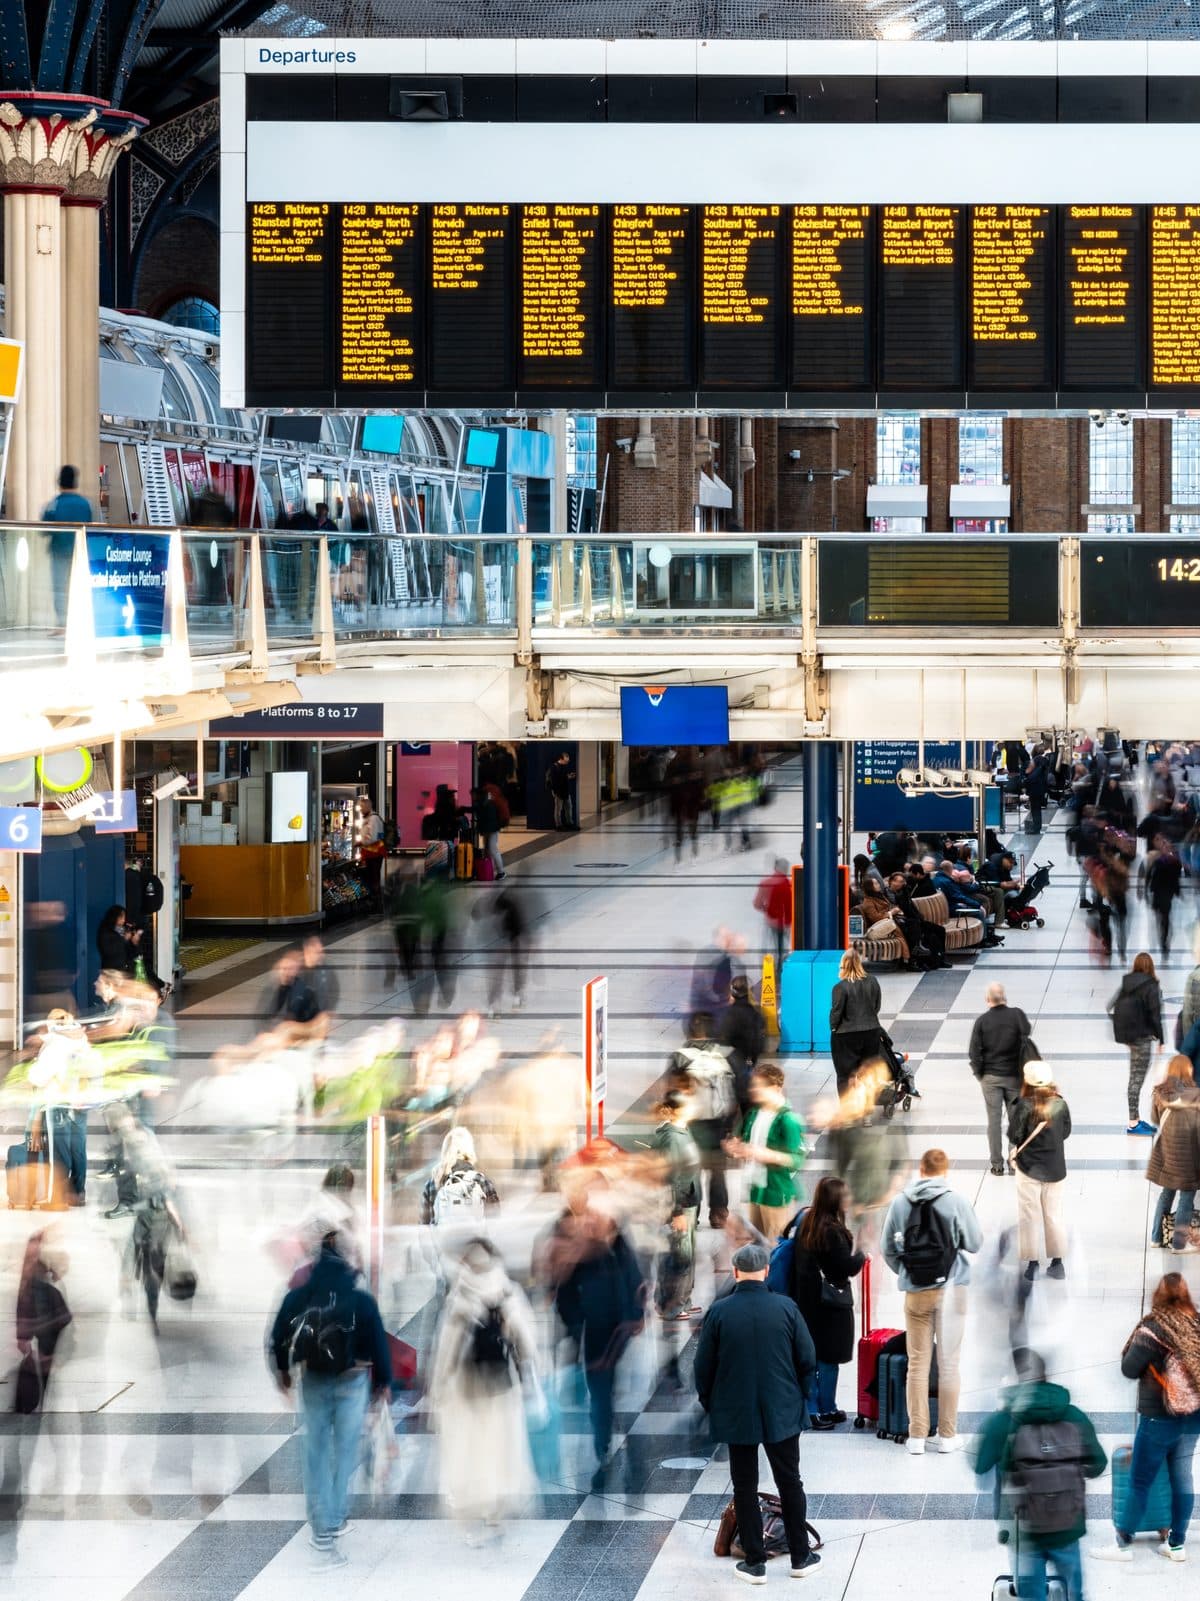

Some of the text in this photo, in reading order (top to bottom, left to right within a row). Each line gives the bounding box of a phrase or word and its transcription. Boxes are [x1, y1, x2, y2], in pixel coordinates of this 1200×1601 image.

[259, 48, 356, 65] Departures
[285, 205, 319, 214] Platform
[323, 205, 328, 214] 3
[375, 206, 409, 214] Platform
[413, 206, 418, 214] 2
[466, 206, 499, 215] Platform
[503, 206, 508, 215] 5
[556, 206, 590, 215] Platform
[592, 206, 598, 215] 6
[646, 206, 680, 215] Platform
[733, 206, 767, 216] Platform
[771, 206, 779, 215] 13
[823, 206, 858, 216] Platform
[862, 207, 869, 216] 11
[916, 207, 950, 216] Platform
[1006, 207, 1040, 216] Platform
[1071, 207, 1132, 217] Special Notices
[253, 217, 322, 228] Stansted Airport
[343, 218, 410, 229] Cambridge North
[433, 219, 464, 228] Norwich
[523, 219, 573, 228] Enfield Town
[614, 219, 652, 229] Chingford
[704, 219, 756, 228] Southend Vic
[794, 219, 861, 229] Colchester Town
[884, 219, 953, 230] Stansted Airport
[974, 219, 1032, 229] Hertford East
[1153, 219, 1190, 229] Cheshunt
[106, 546, 152, 565] Customer Lounge
[132, 572, 138, 585] to
[139, 570, 160, 586] Platform
[261, 706, 357, 718] Platforms 8 to 17
[874, 750, 899, 758] Transport
[9, 815, 28, 841] 6
